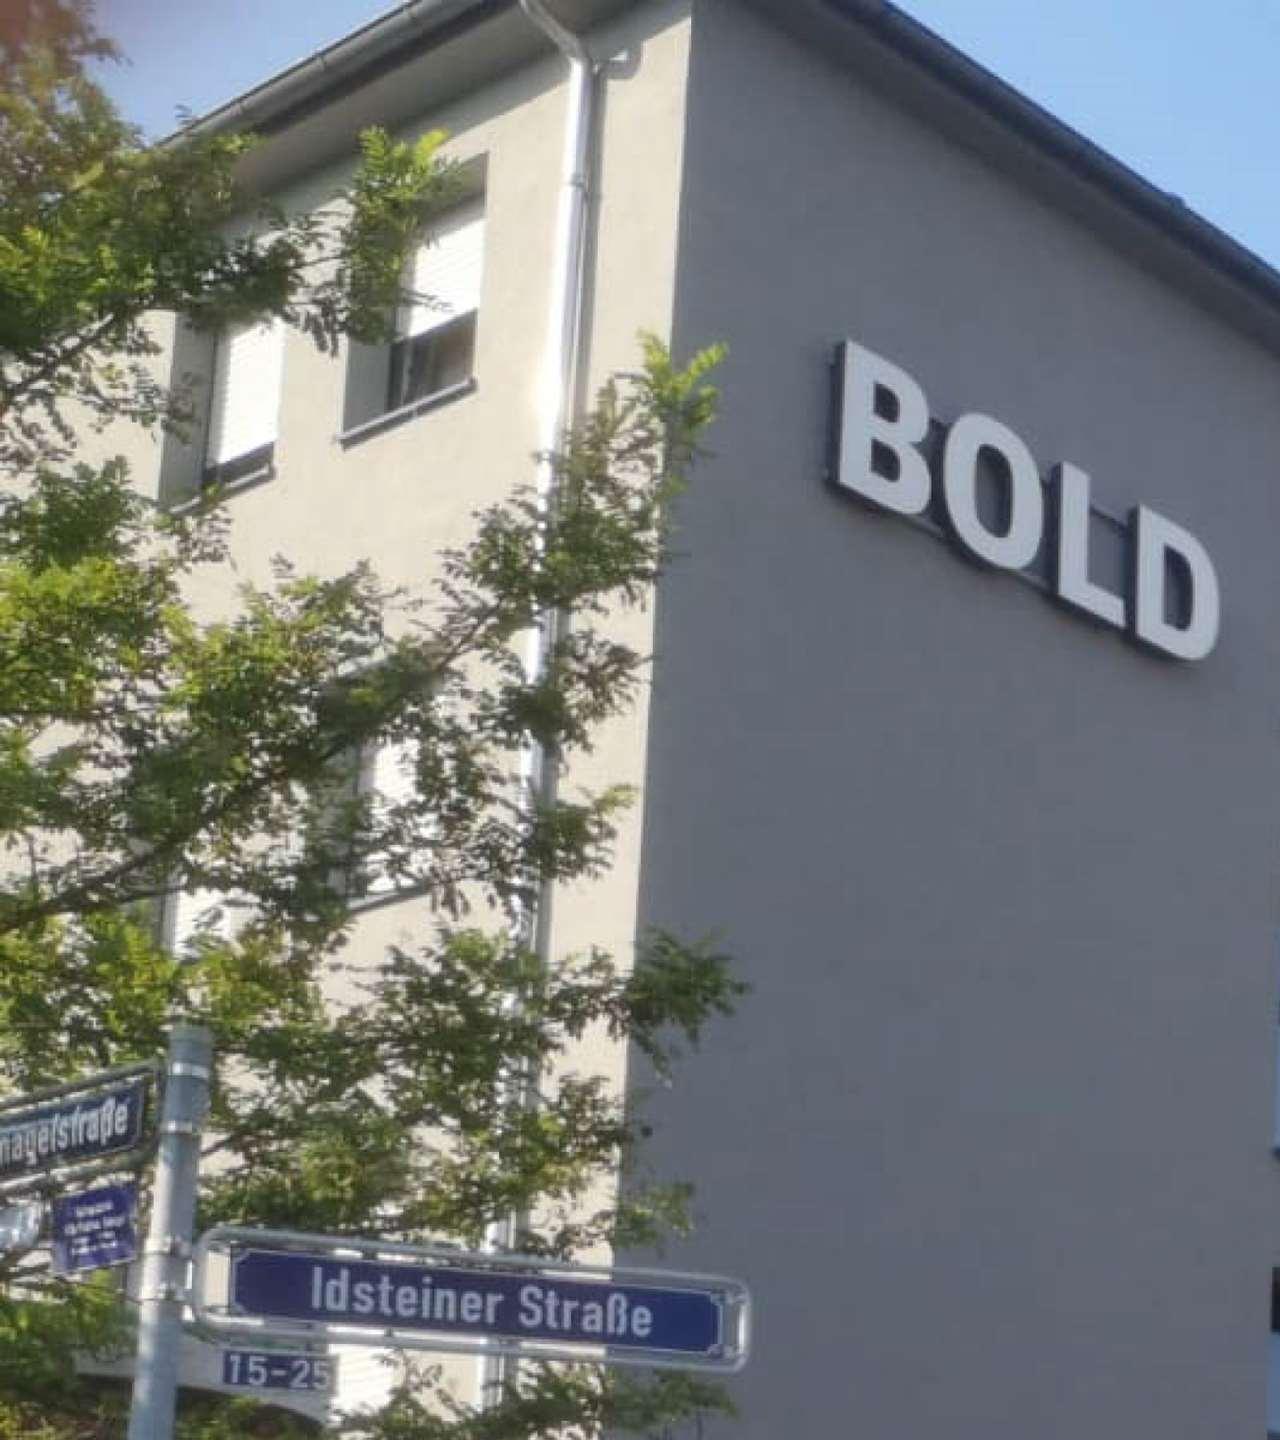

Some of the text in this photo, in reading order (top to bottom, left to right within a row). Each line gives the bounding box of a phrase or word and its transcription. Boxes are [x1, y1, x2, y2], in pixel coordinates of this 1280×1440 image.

[830, 338, 1219, 660] BOLD
[310, 1266, 653, 1337] Idsteiner Straße
[230, 1354, 330, 1390] 15-25
